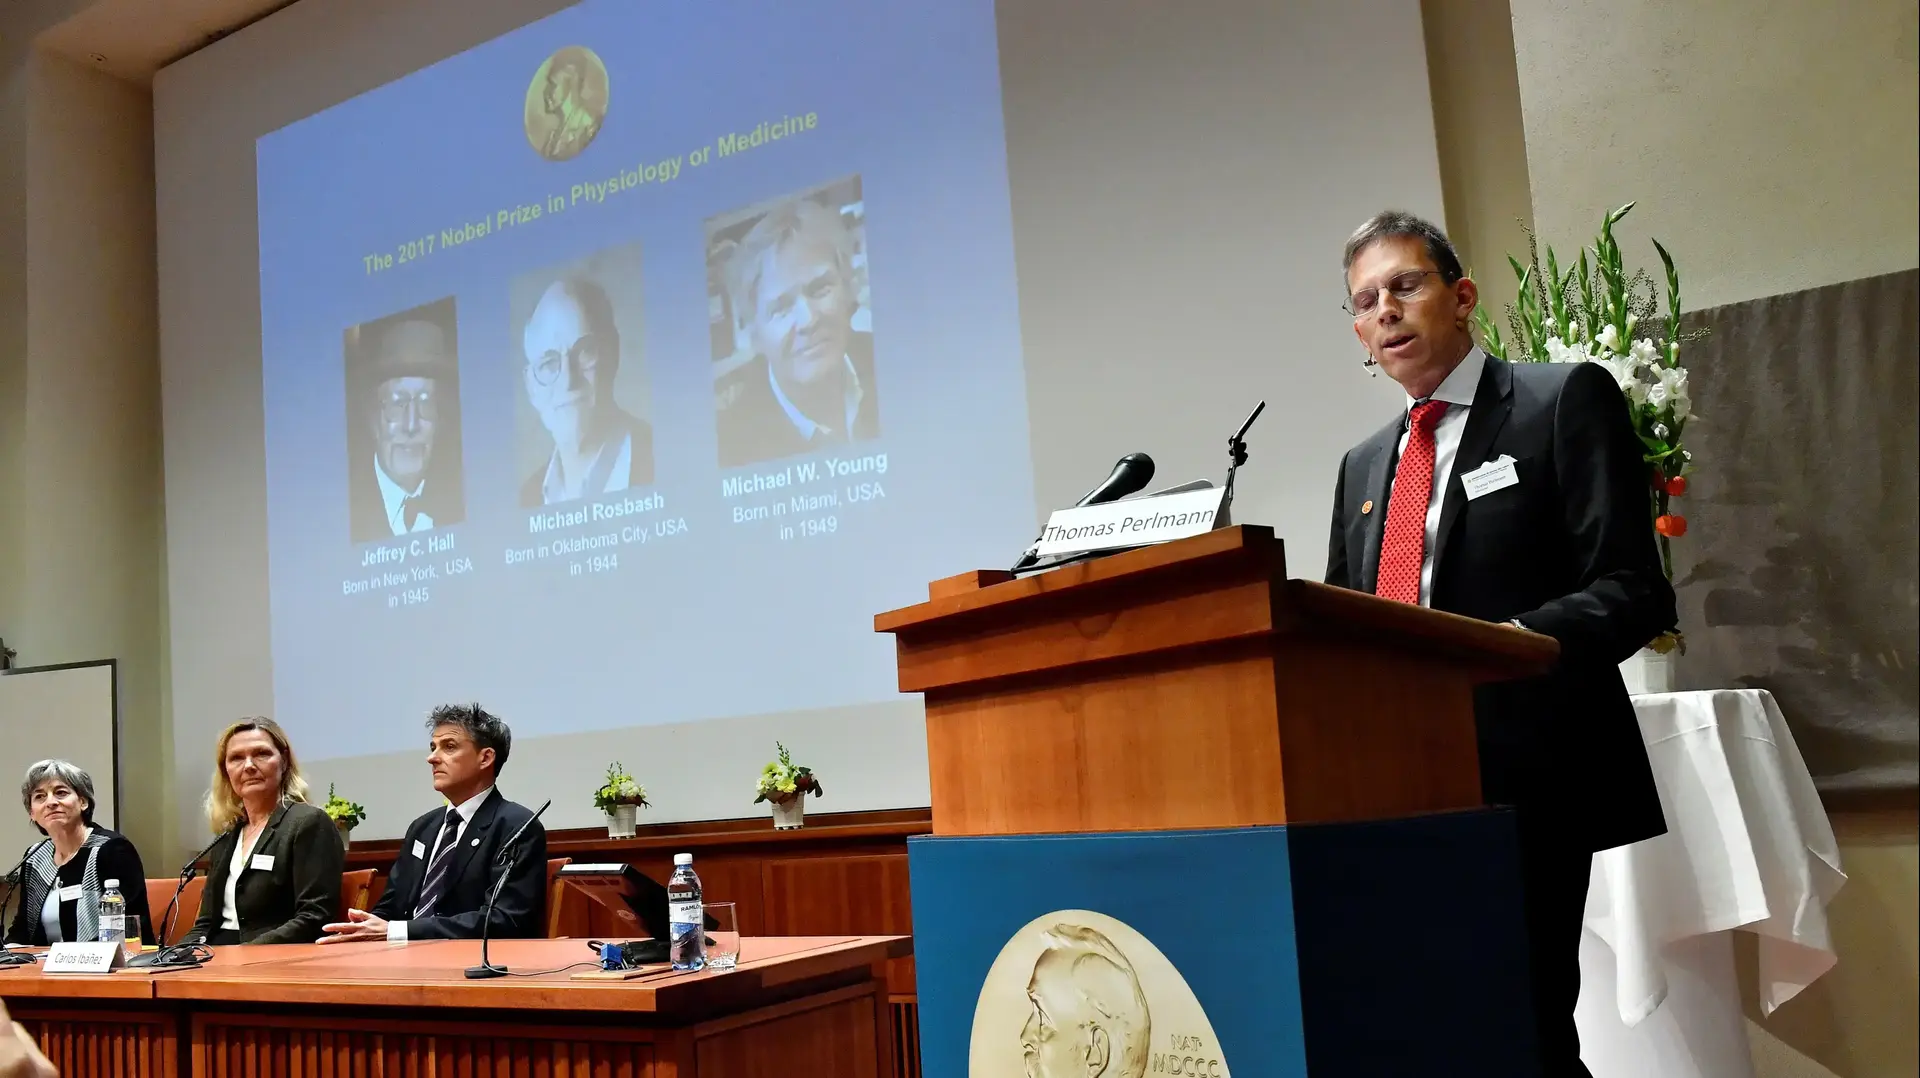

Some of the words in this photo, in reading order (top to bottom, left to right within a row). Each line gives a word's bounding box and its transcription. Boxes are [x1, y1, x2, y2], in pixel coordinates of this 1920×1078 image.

[363, 253, 393, 275] The
[398, 235, 435, 263] 2017
[441, 215, 491, 249] Nobel
[497, 203, 542, 230] Prize
[548, 194, 565, 213] in
[571, 155, 683, 206] Physiology
[689, 146, 711, 166] or
[718, 111, 818, 158] Medicine
[722, 467, 791, 497] Michael
[796, 461, 820, 484] W.
[825, 452, 888, 478] Young
[529, 506, 588, 533] Michael
[592, 491, 664, 521] Rosbash
[733, 505, 768, 523] Born
[773, 500, 786, 516] in
[791, 490, 842, 513] Miami,
[847, 481, 886, 503] USA
[505, 548, 534, 564] Born
[538, 543, 549, 558] in
[552, 533, 618, 556] Oklahoma
[622, 526, 651, 543] City,
[655, 517, 688, 537] USA
[780, 524, 793, 540] in
[800, 515, 838, 537] 1949
[1047, 522, 1115, 543] Thomas
[1120, 509, 1214, 533] Perlmann
[361, 546, 406, 567] Jeffrey
[410, 540, 424, 556] C.
[428, 532, 455, 553] Hall
[570, 561, 582, 576] in
[586, 553, 618, 573] 1944
[342, 579, 368, 595] Born
[370, 574, 381, 589] in
[383, 572, 408, 587] New
[411, 564, 439, 581] York,
[445, 557, 473, 574] USA
[388, 593, 398, 608] in
[402, 587, 429, 605] 1945
[54, 952, 77, 964] Carlos
[1153, 1052, 1221, 1078] MDCCC
